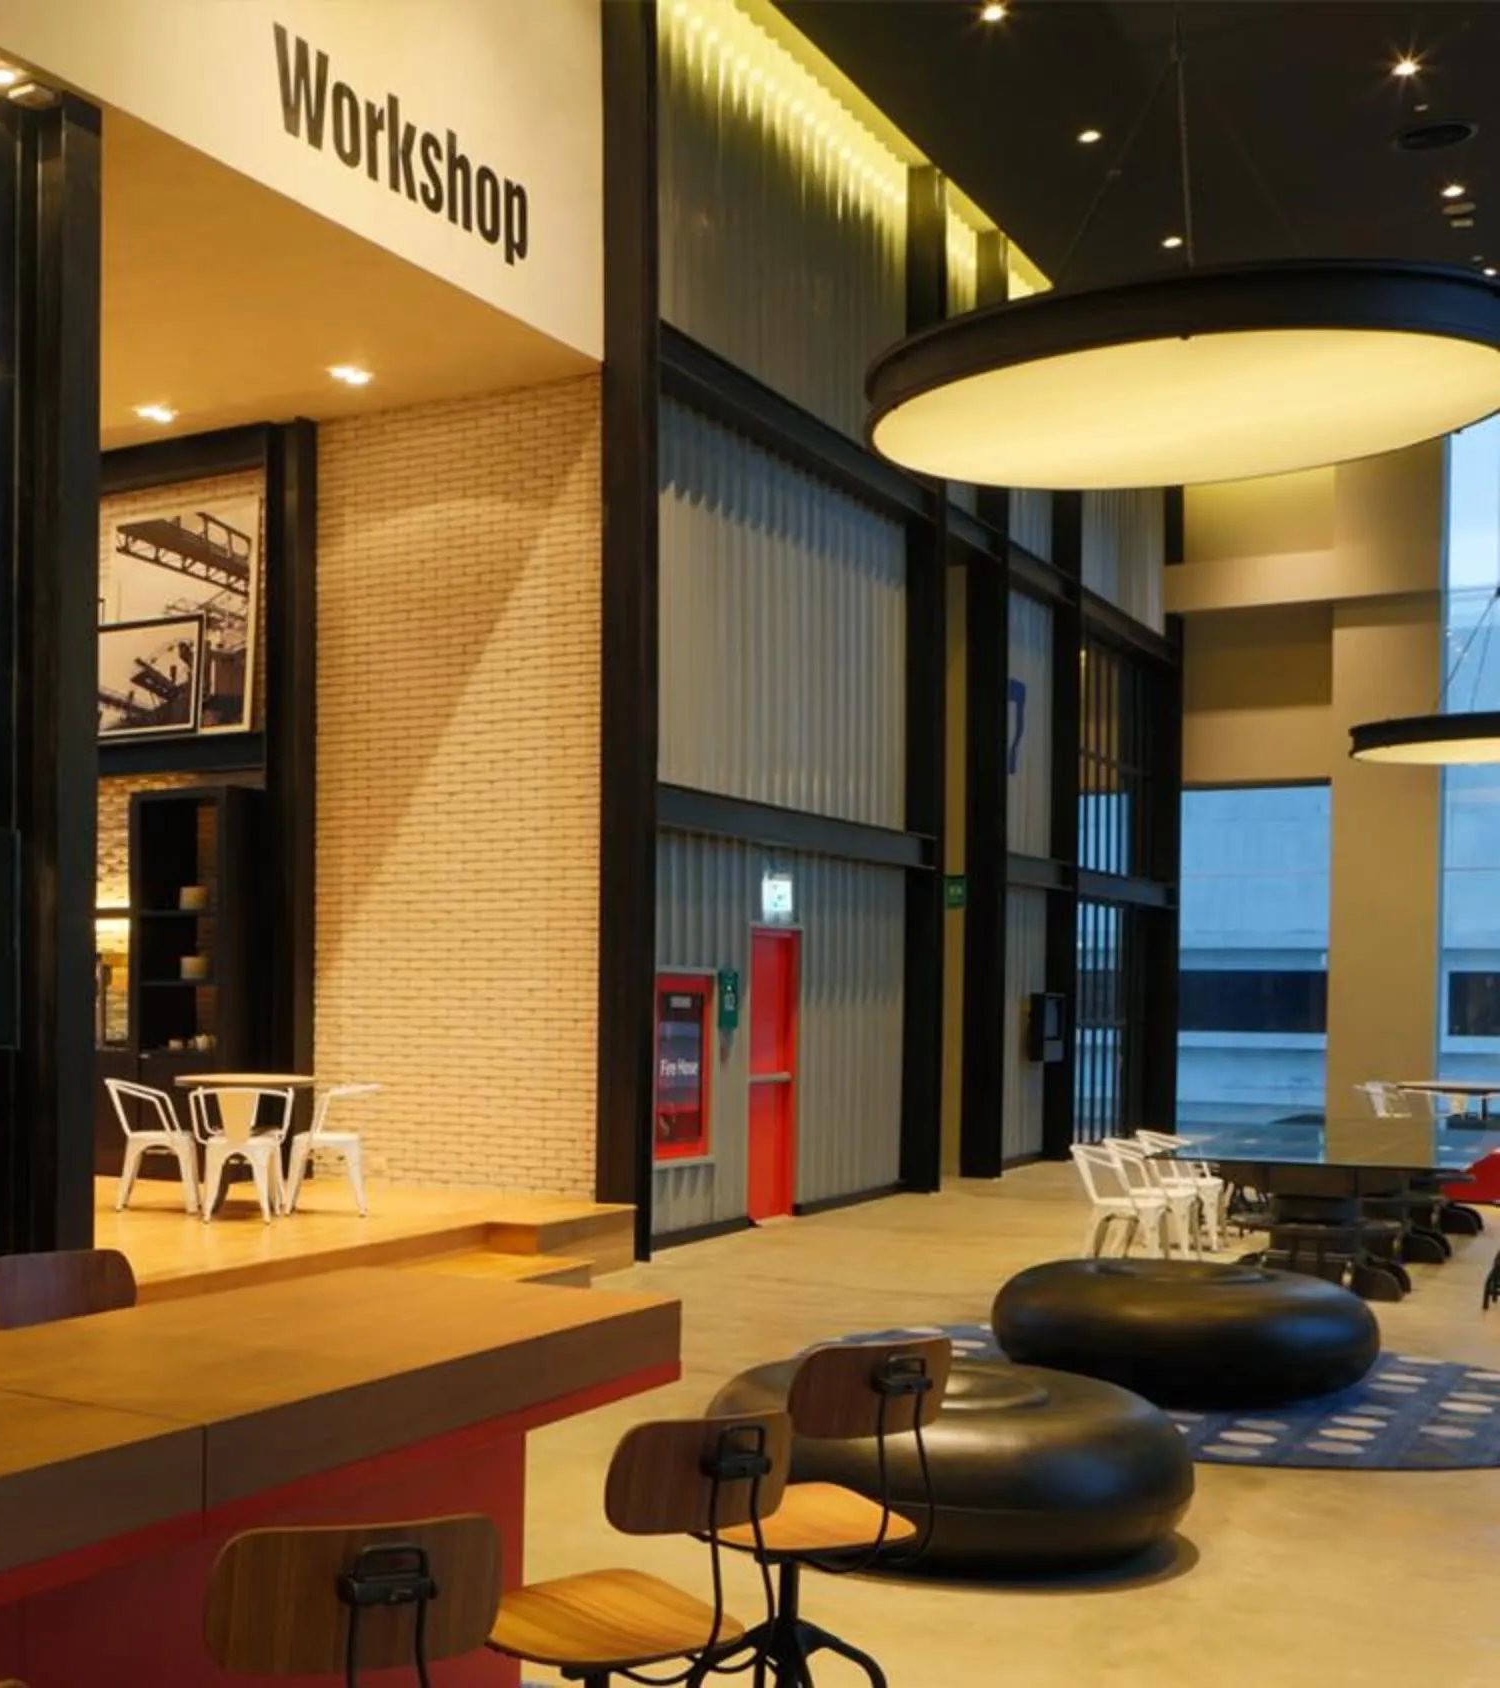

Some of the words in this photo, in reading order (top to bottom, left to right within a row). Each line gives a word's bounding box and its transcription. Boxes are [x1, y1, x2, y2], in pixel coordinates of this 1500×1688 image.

[273, 21, 528, 266] Workshop
[659, 1058, 676, 1077] Fire
[677, 1057, 698, 1076] Hose
